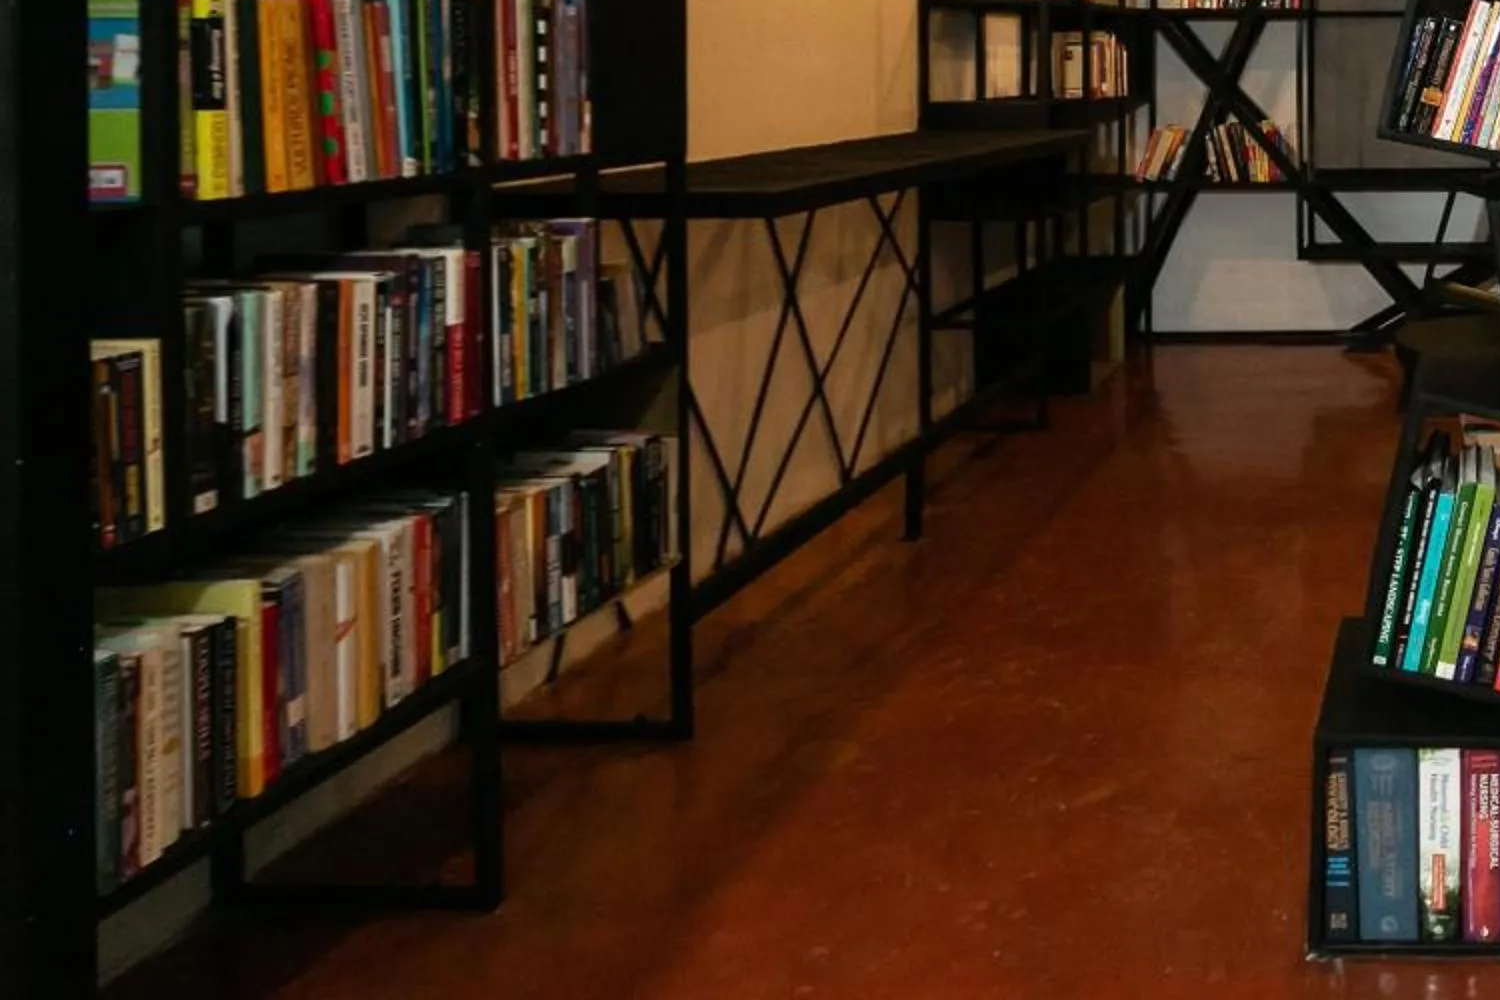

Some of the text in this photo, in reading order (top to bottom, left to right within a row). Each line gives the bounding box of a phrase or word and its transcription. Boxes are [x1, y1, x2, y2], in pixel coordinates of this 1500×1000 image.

[1379, 572, 1399, 643] LANDSCAPING
[1479, 773, 1489, 821] NURSING
[1489, 773, 1500, 870] MEDICAL-SURGICAL
